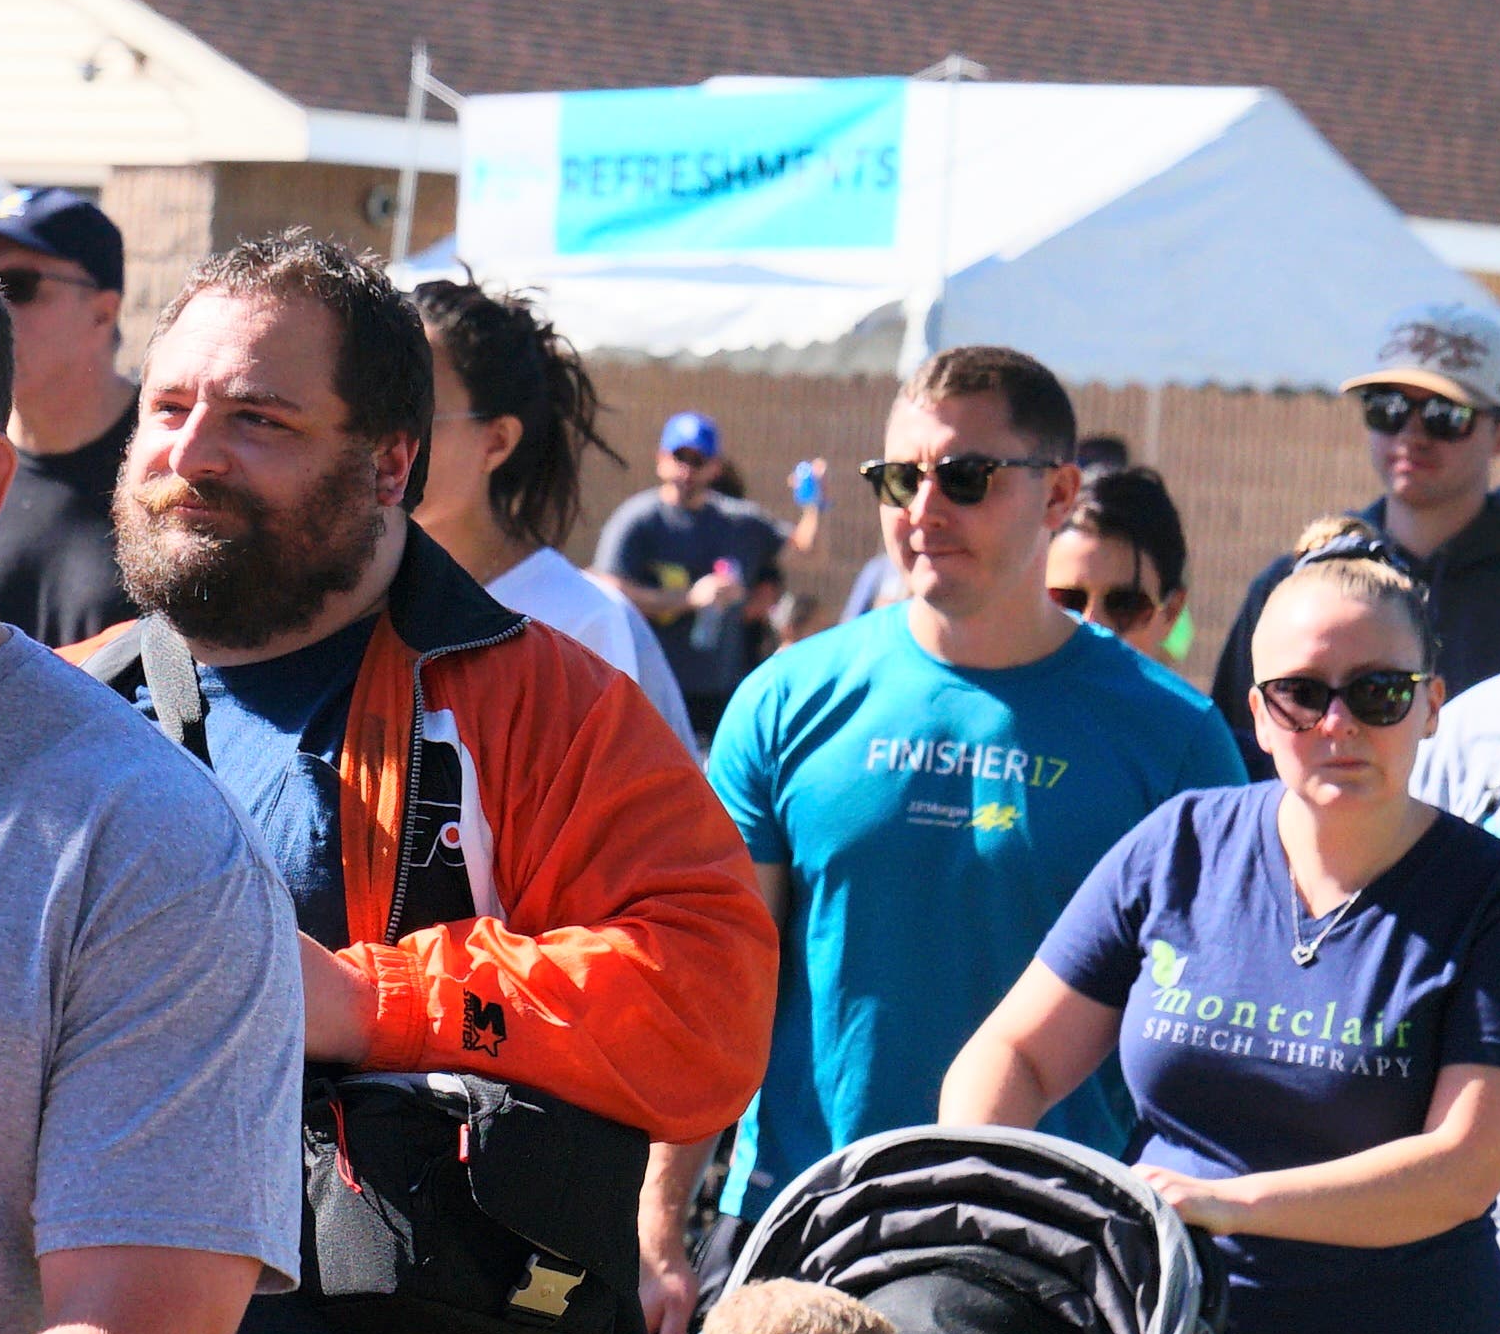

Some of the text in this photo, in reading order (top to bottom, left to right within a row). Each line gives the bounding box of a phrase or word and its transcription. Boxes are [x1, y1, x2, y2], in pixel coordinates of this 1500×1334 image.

[562, 146, 897, 198] REFRESHMNTS
[866, 738, 1068, 790] FINISHER 17
[1154, 986, 1412, 1049] montclair
[1142, 1016, 1413, 1079] SPEECH THERAPY
